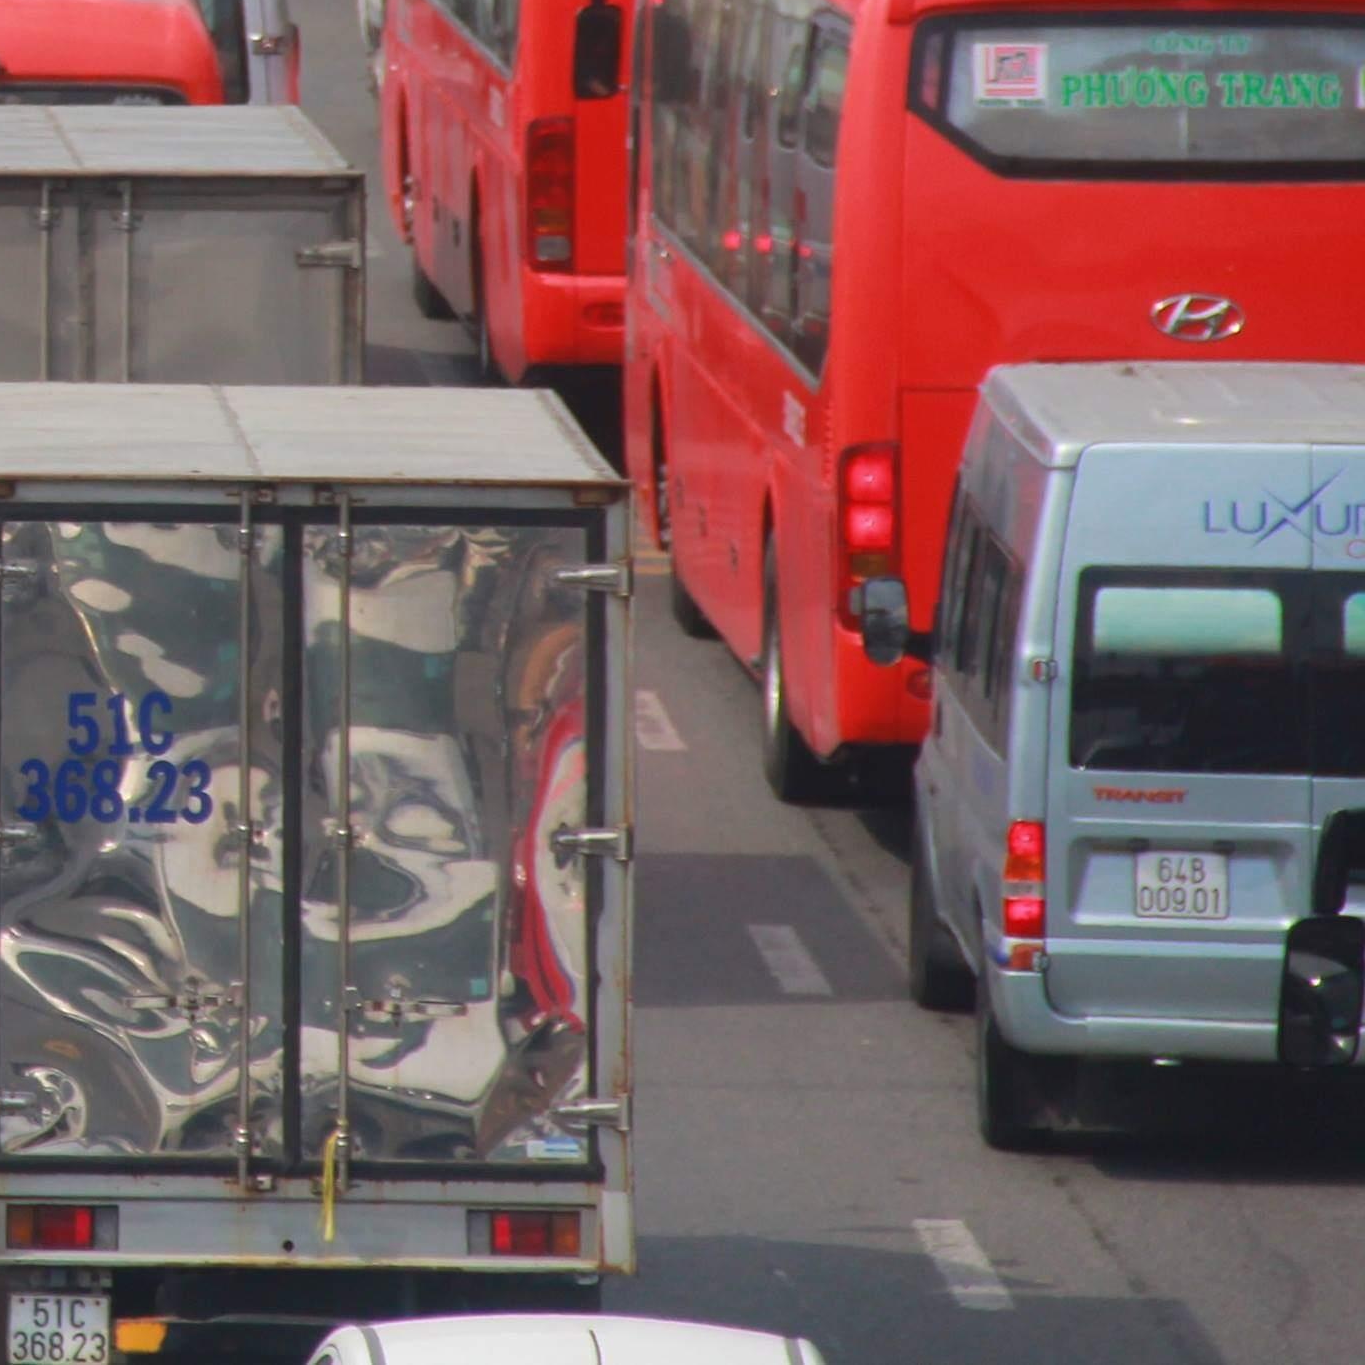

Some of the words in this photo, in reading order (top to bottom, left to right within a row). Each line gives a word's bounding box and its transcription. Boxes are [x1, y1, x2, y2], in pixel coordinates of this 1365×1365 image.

[1061, 62, 1209, 109] PHƯƠNG
[1216, 72, 1343, 110] TRANG
[67, 691, 174, 756] 51C
[17, 759, 213, 825] 368.23
[1092, 787, 1187, 805] TRANSIT
[1156, 856, 1208, 886] 64B
[1139, 885, 1222, 916] 009.01
[32, 1297, 88, 1330] 51C
[11, 1331, 107, 1365] 368.23
